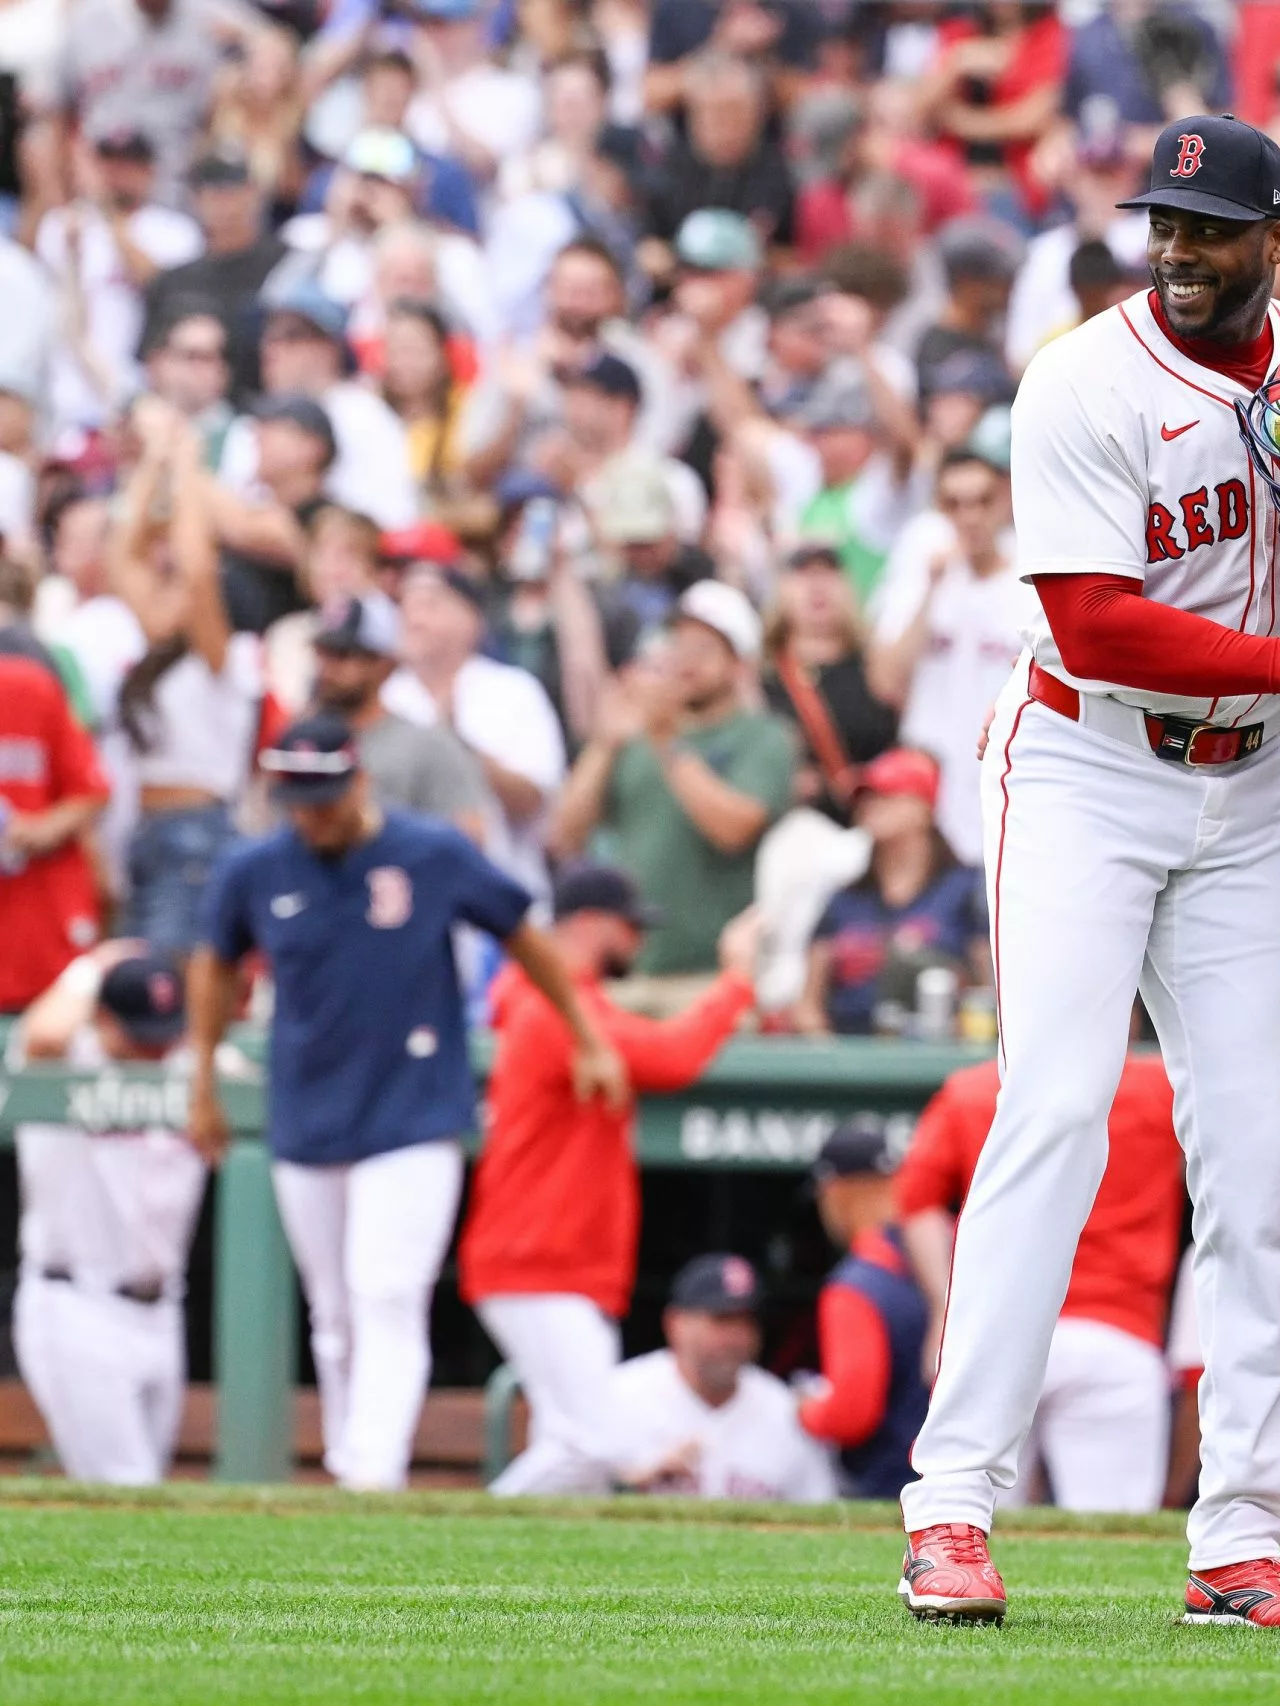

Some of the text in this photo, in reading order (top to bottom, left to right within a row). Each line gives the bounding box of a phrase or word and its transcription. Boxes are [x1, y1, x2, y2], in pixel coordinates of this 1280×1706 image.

[1170, 134, 1206, 178] B
[1145, 478, 1250, 564] RED
[1245, 729, 1260, 750] 44
